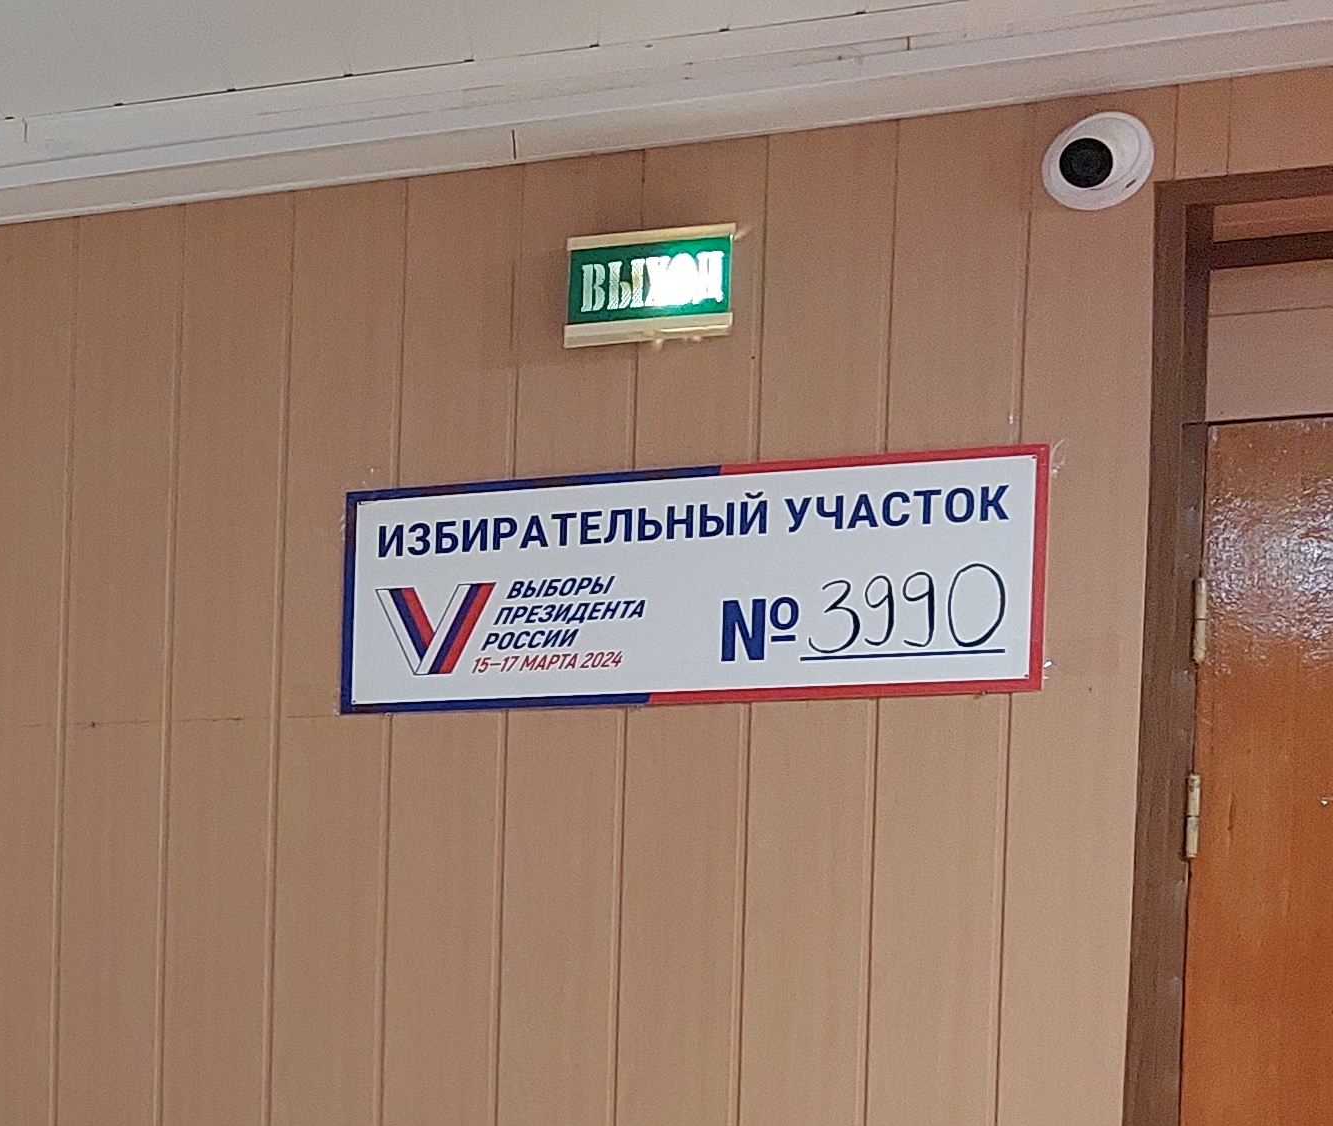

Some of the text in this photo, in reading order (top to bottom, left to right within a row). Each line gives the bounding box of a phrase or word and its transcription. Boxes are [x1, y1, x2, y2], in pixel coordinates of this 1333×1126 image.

[377, 485, 1010, 558] ИЗБИРАТЕЛЬНЫЙ УЧАСТОК
[506, 576, 616, 600] ВЫБОРЫ
[493, 599, 646, 625] ПРЕЗИДЕНТА
[481, 628, 579, 651] РОССИИ
[519, 653, 578, 672] МАРТА
[579, 651, 623, 669] 2024
